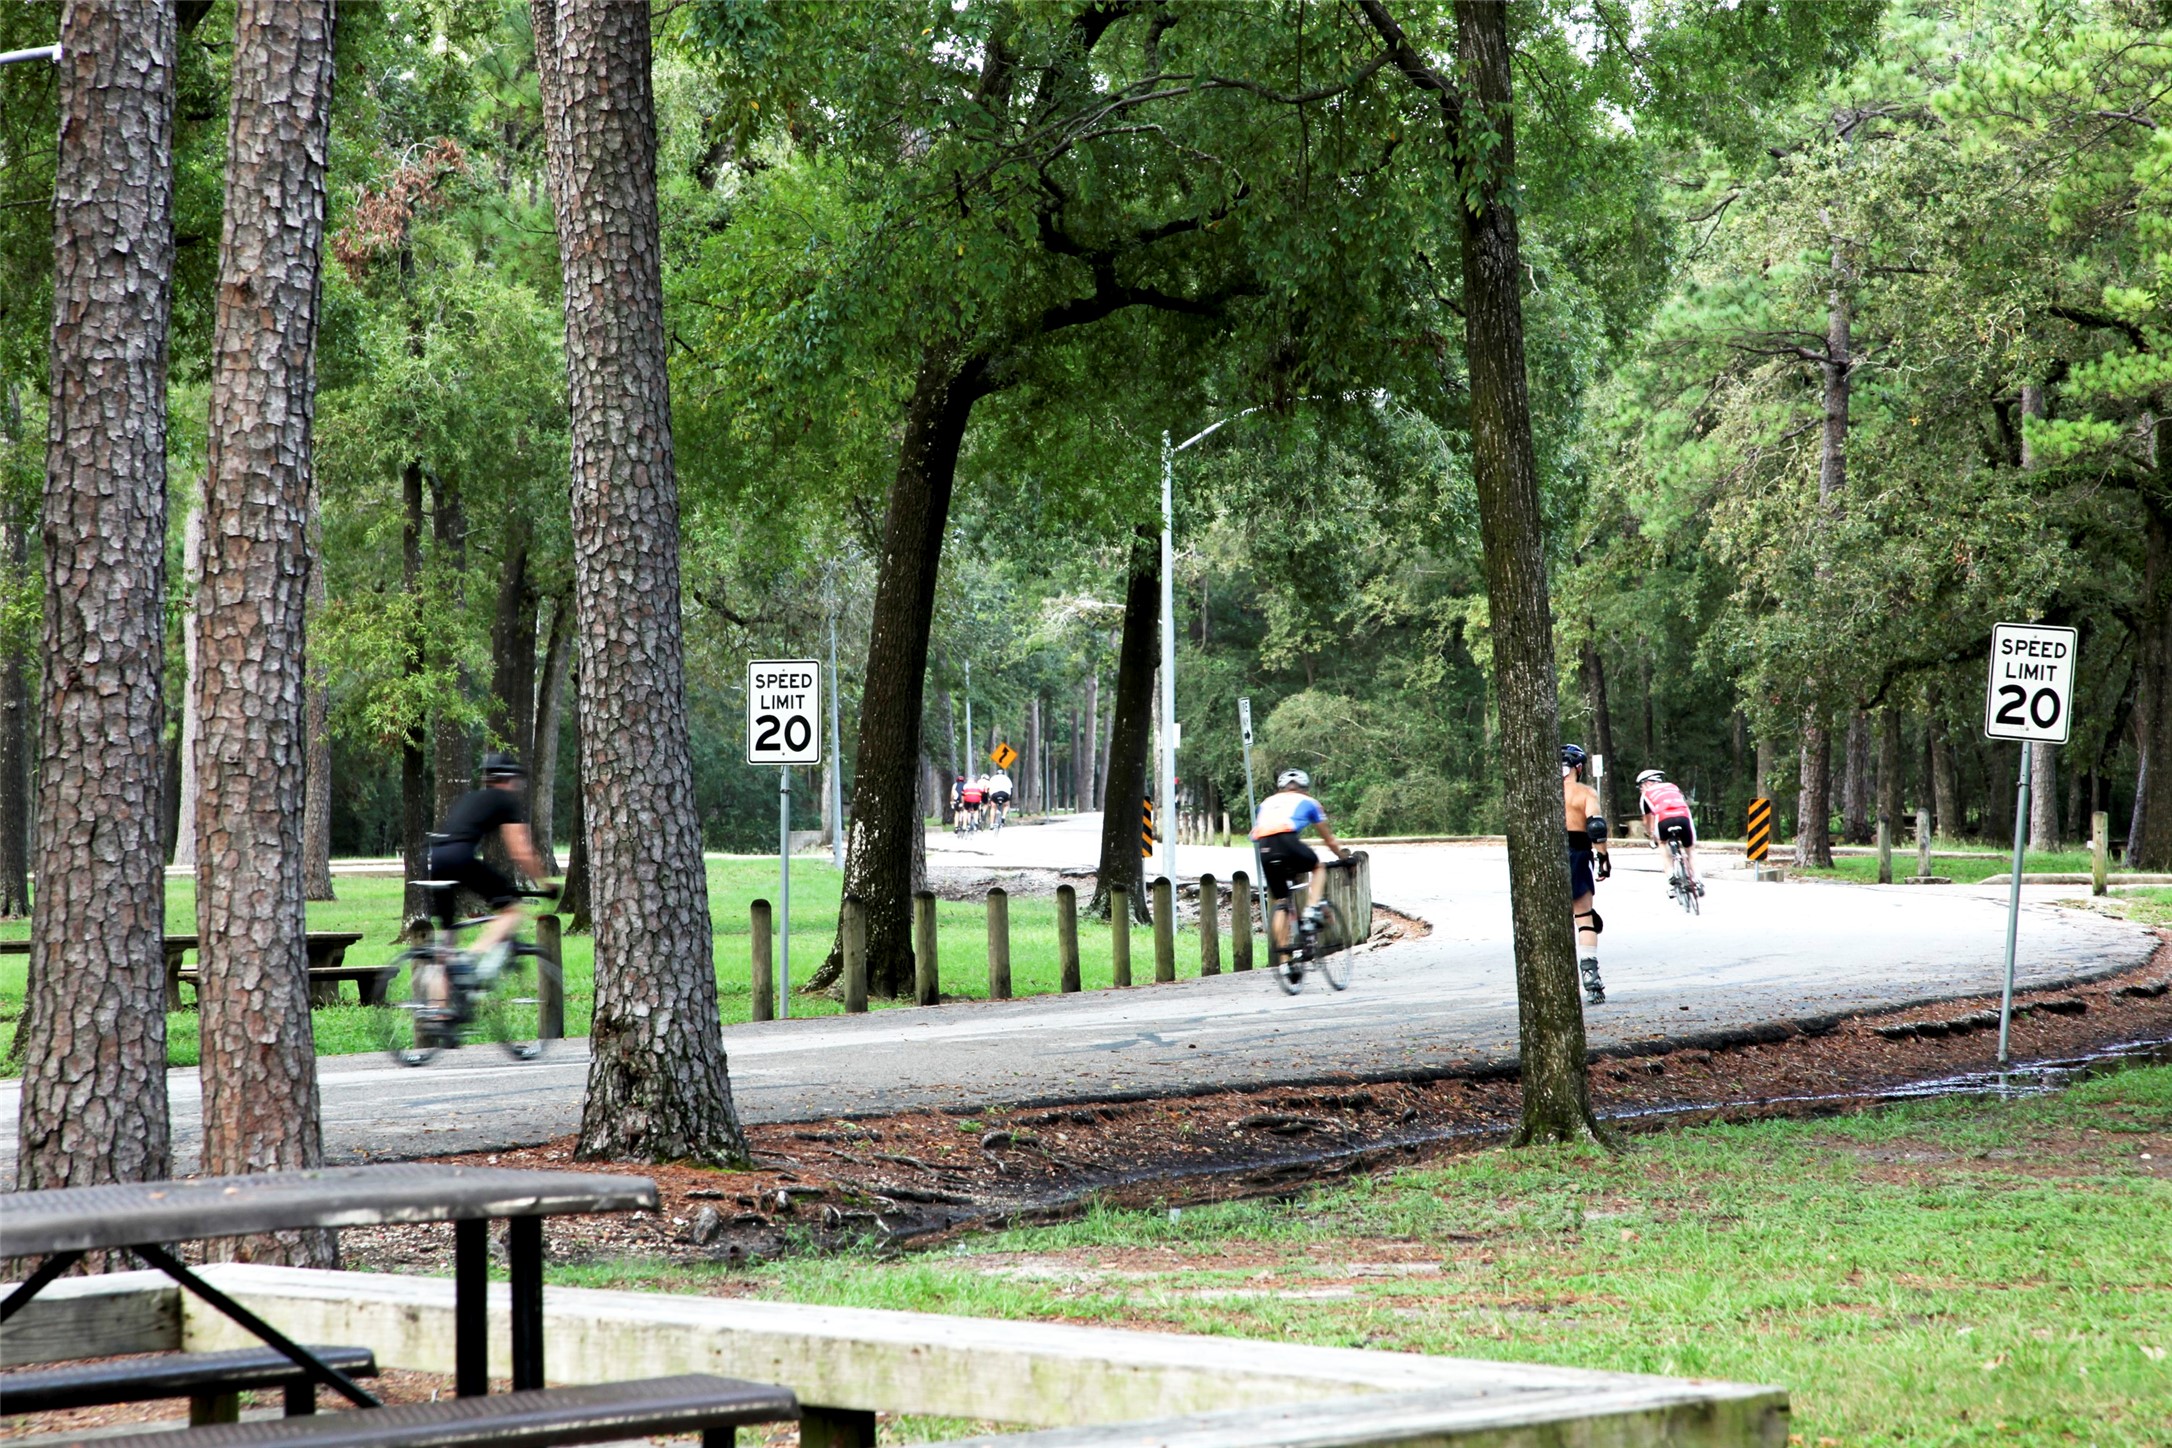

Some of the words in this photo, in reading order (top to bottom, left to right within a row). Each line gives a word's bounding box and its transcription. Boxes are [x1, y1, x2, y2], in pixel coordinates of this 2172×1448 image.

[2001, 638, 2067, 659] SPEED
[755, 673, 813, 689] SPEED
[2005, 662, 2058, 682] LIMIT
[761, 694, 805, 710] LIMIT
[1995, 684, 2061, 729] 20
[755, 714, 812, 752] 20
